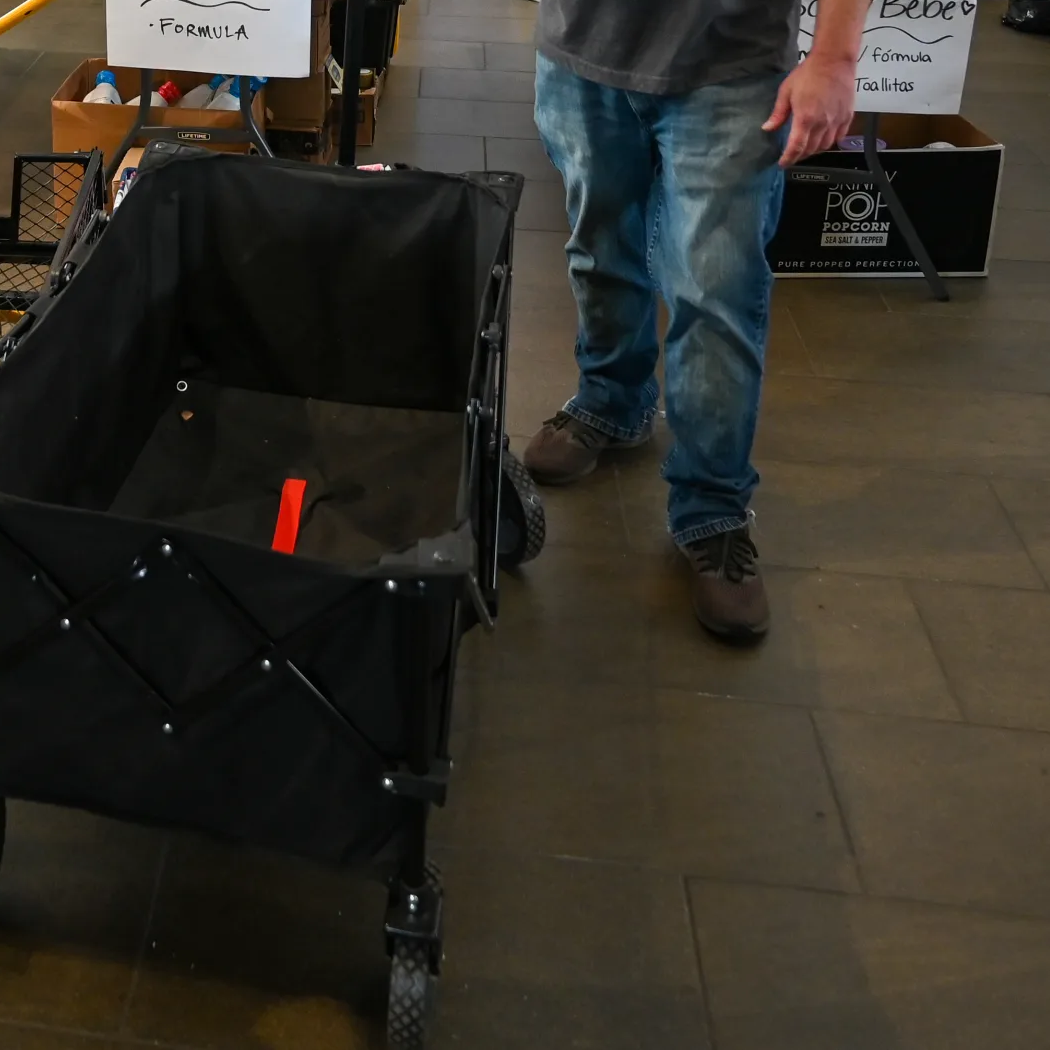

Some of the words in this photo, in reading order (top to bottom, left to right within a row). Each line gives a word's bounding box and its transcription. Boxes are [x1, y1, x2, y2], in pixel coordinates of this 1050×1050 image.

[159, 18, 250, 41] FORMULA
[872, 46, 933, 63] fórmula
[854, 77, 914, 93] Toallitas
[822, 221, 891, 232] POPCORN
[825, 236, 837, 244] SEA
[838, 236, 853, 244] SALT
[860, 236, 884, 244] PEPPER
